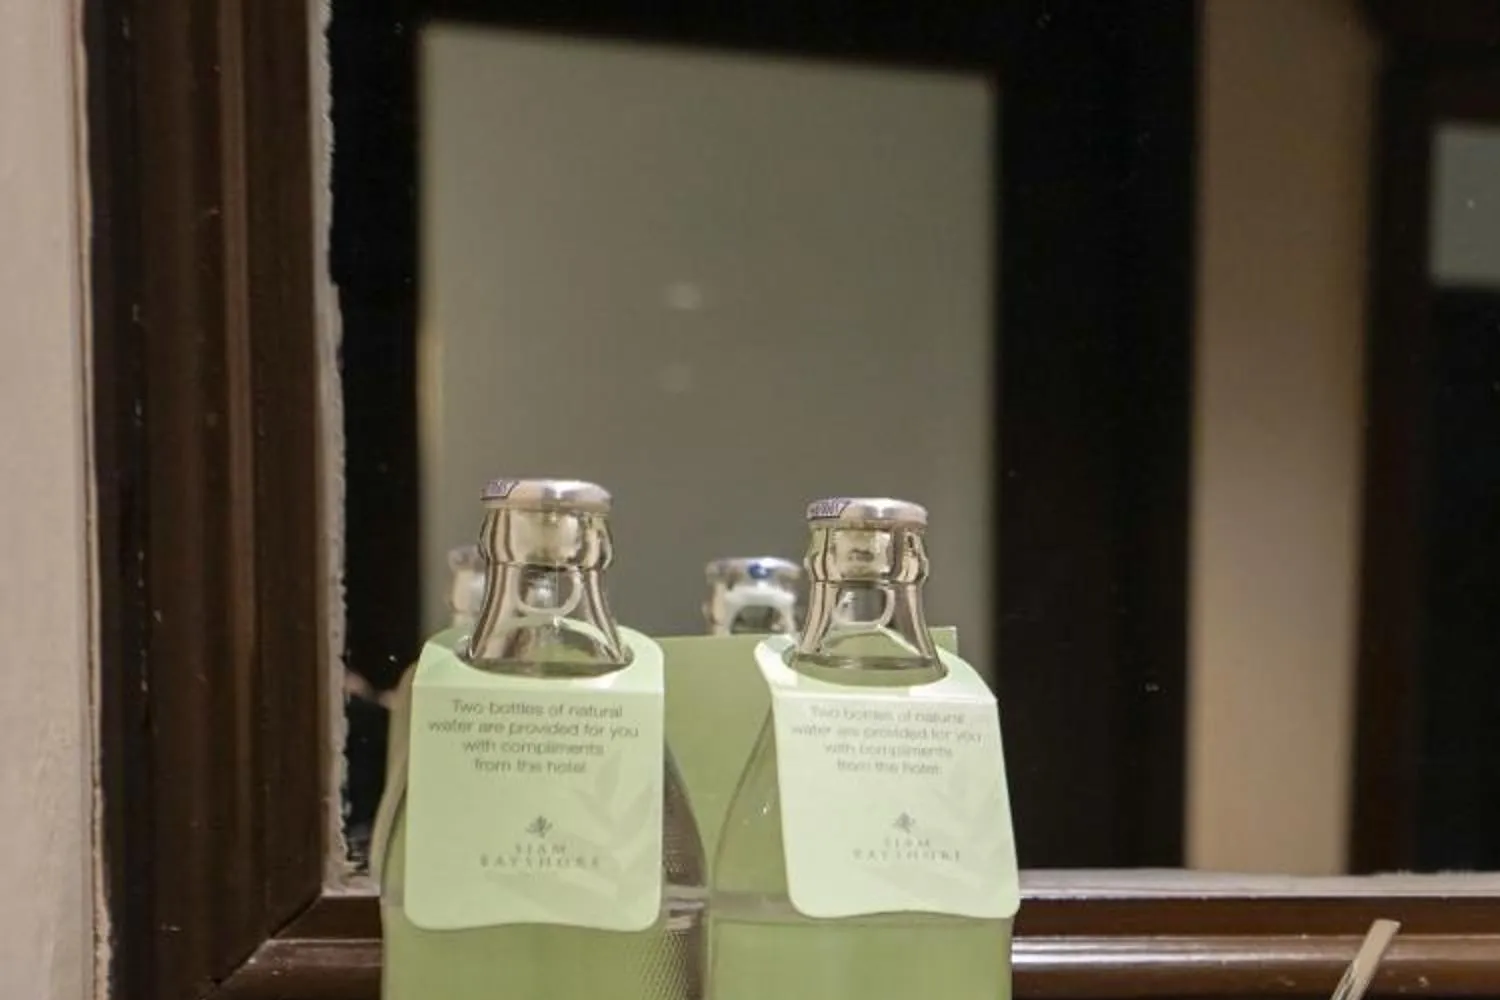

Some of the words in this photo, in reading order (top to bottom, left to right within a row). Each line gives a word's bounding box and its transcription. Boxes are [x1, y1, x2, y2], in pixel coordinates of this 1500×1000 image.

[451, 699, 484, 716] Two
[489, 700, 544, 717] bottles
[548, 701, 565, 717] of
[568, 702, 624, 719] natural
[427, 718, 475, 734] water
[478, 721, 506, 735] are
[508, 721, 579, 738] provided
[583, 722, 605, 739] for
[609, 725, 640, 742] you
[461, 738, 497, 754] with
[501, 741, 605, 759] compliments
[474, 757, 512, 773] from
[516, 758, 543, 775] the
